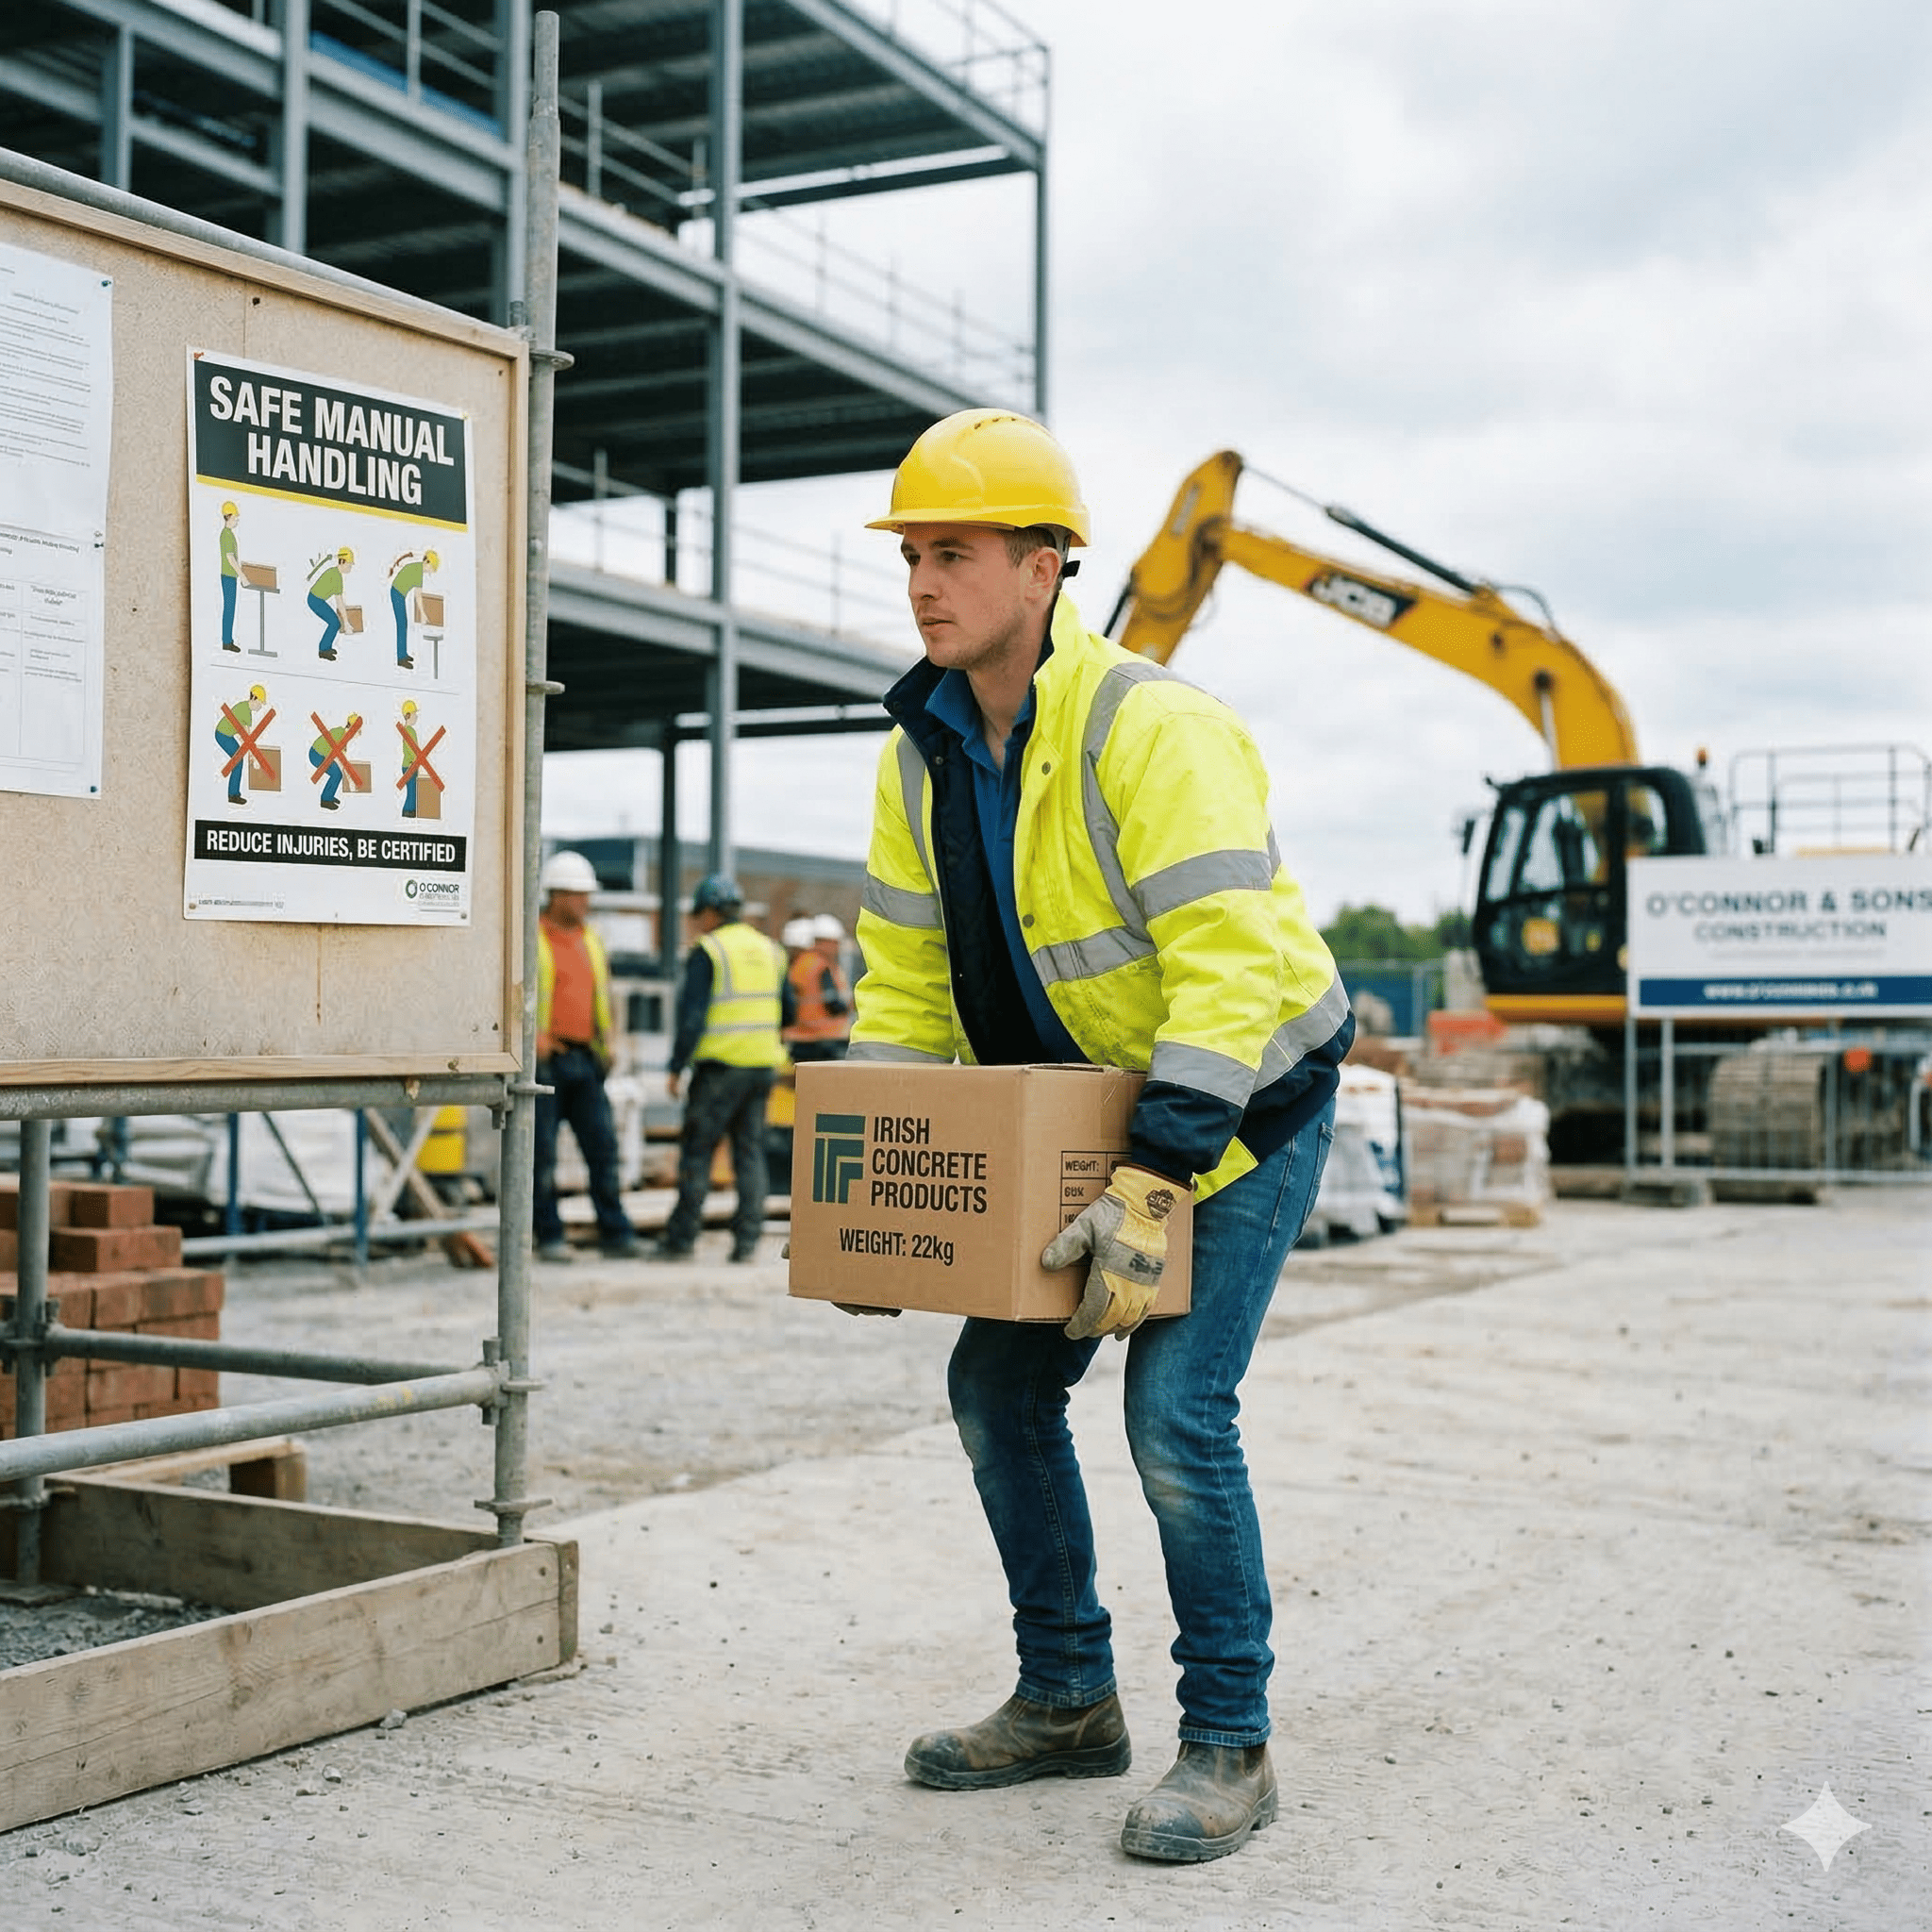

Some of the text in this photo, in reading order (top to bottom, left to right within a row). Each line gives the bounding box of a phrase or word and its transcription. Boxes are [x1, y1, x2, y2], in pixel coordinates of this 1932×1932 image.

[209, 375, 455, 466] SAFE MANUAL
[247, 431, 422, 505] HANDLING
[207, 829, 456, 863] REDUCE INJURIES, BE CERTIFIED
[1646, 888, 1932, 917] O'CONNOR & SONS
[1694, 921, 1887, 941] CONSTRUCTION
[874, 1116, 930, 1144] IRISH
[872, 1147, 988, 1180] CONCRETE
[1065, 1160, 1100, 1172] WEIGHT:
[871, 1180, 988, 1214] PRODUCTS
[840, 1227, 955, 1266] WEIGHT: 22kg
